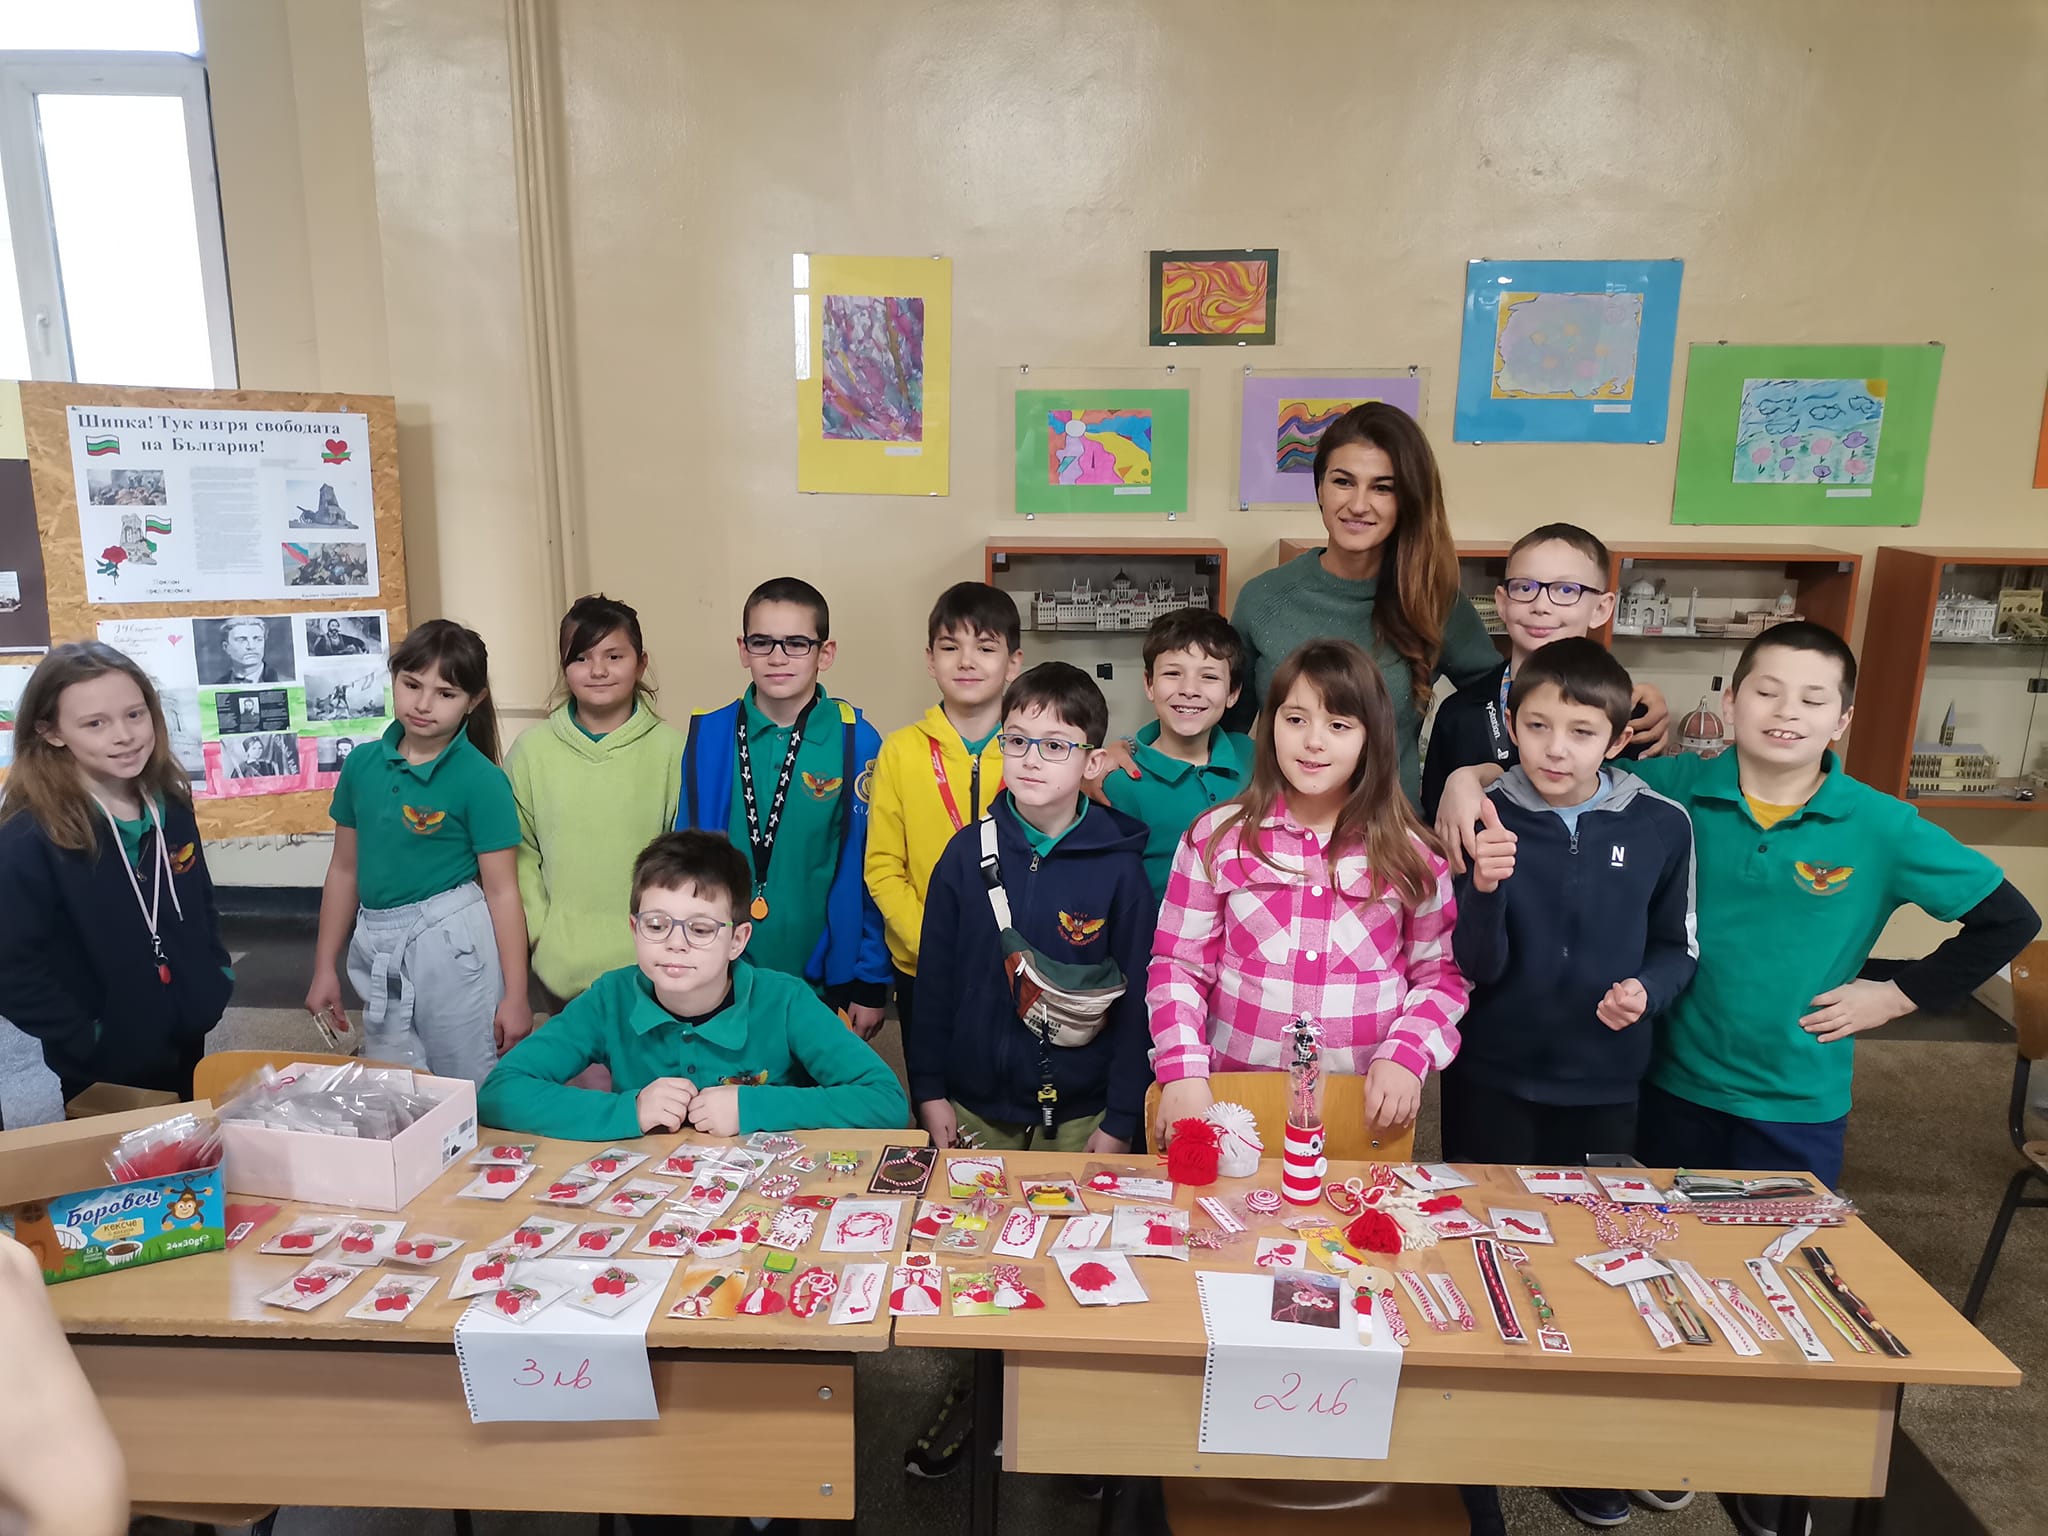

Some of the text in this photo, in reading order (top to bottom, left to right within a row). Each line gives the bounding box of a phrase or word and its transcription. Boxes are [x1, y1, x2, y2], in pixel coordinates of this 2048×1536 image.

[78, 414, 340, 434] Шипка! Тук изгря свободата
[142, 437, 265, 455] на България!
[1611, 845, 1625, 862] N
[67, 1191, 160, 1228] Боровец
[513, 1358, 592, 1389] 3 лв
[1254, 1372, 1301, 1411] 2
